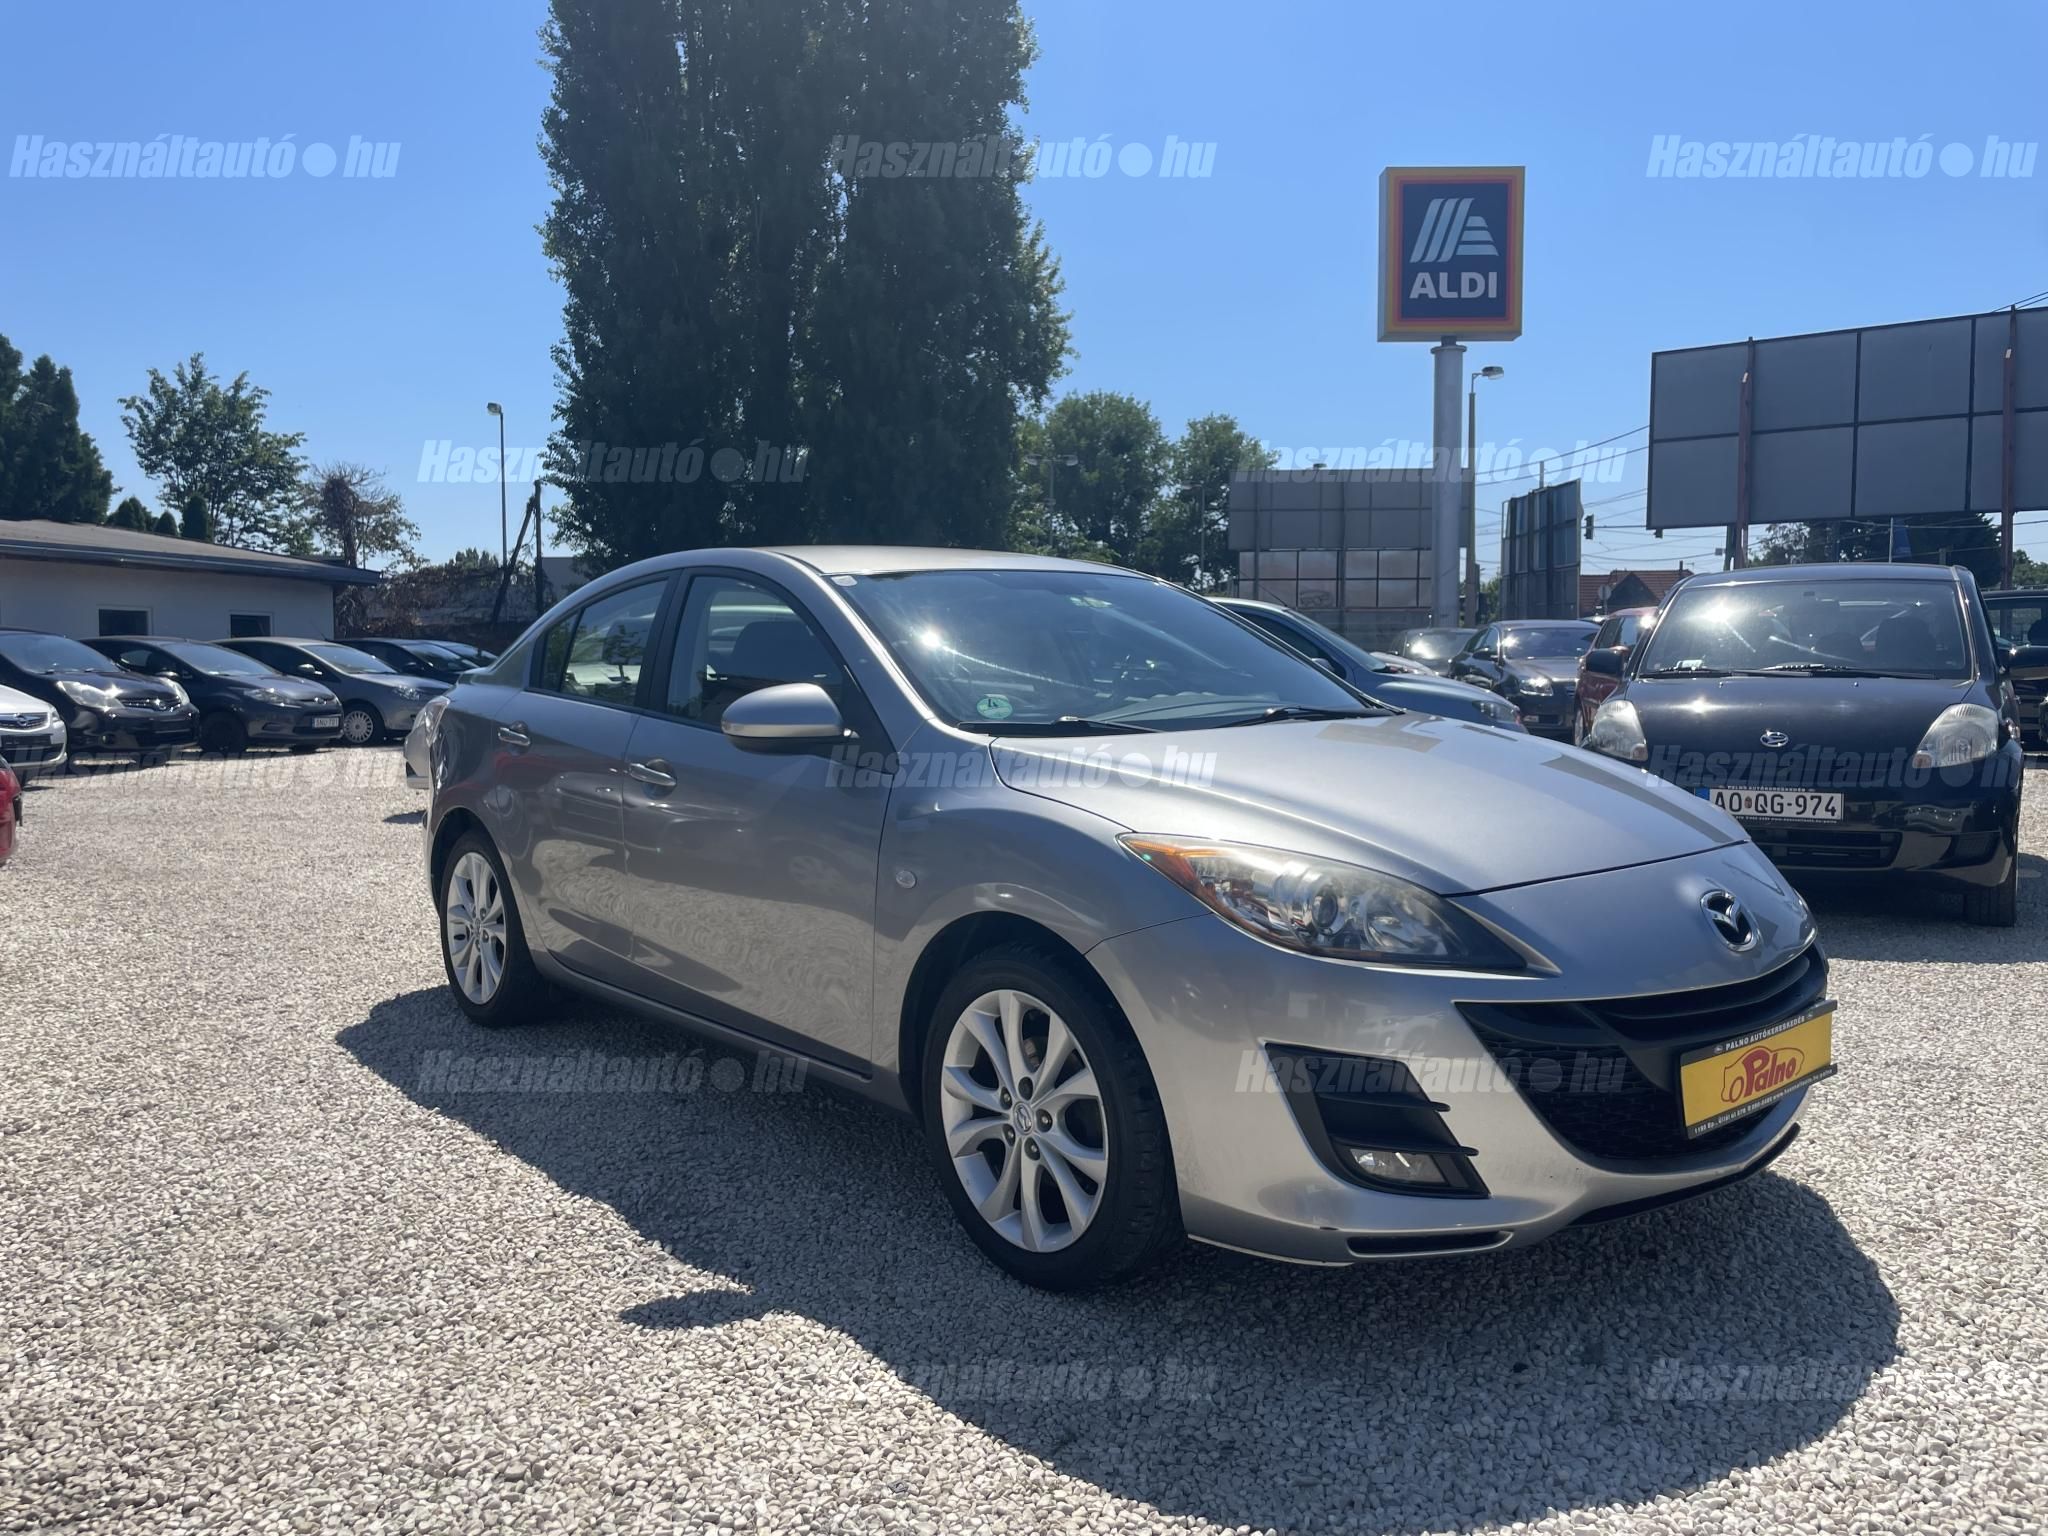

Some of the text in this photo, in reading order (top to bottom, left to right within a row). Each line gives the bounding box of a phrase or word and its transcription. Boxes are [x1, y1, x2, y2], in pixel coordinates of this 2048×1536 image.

[1409, 271, 1498, 299] ALDI
[1725, 1036, 1749, 1051] PALNO
[1742, 1048, 1797, 1097] Palno
